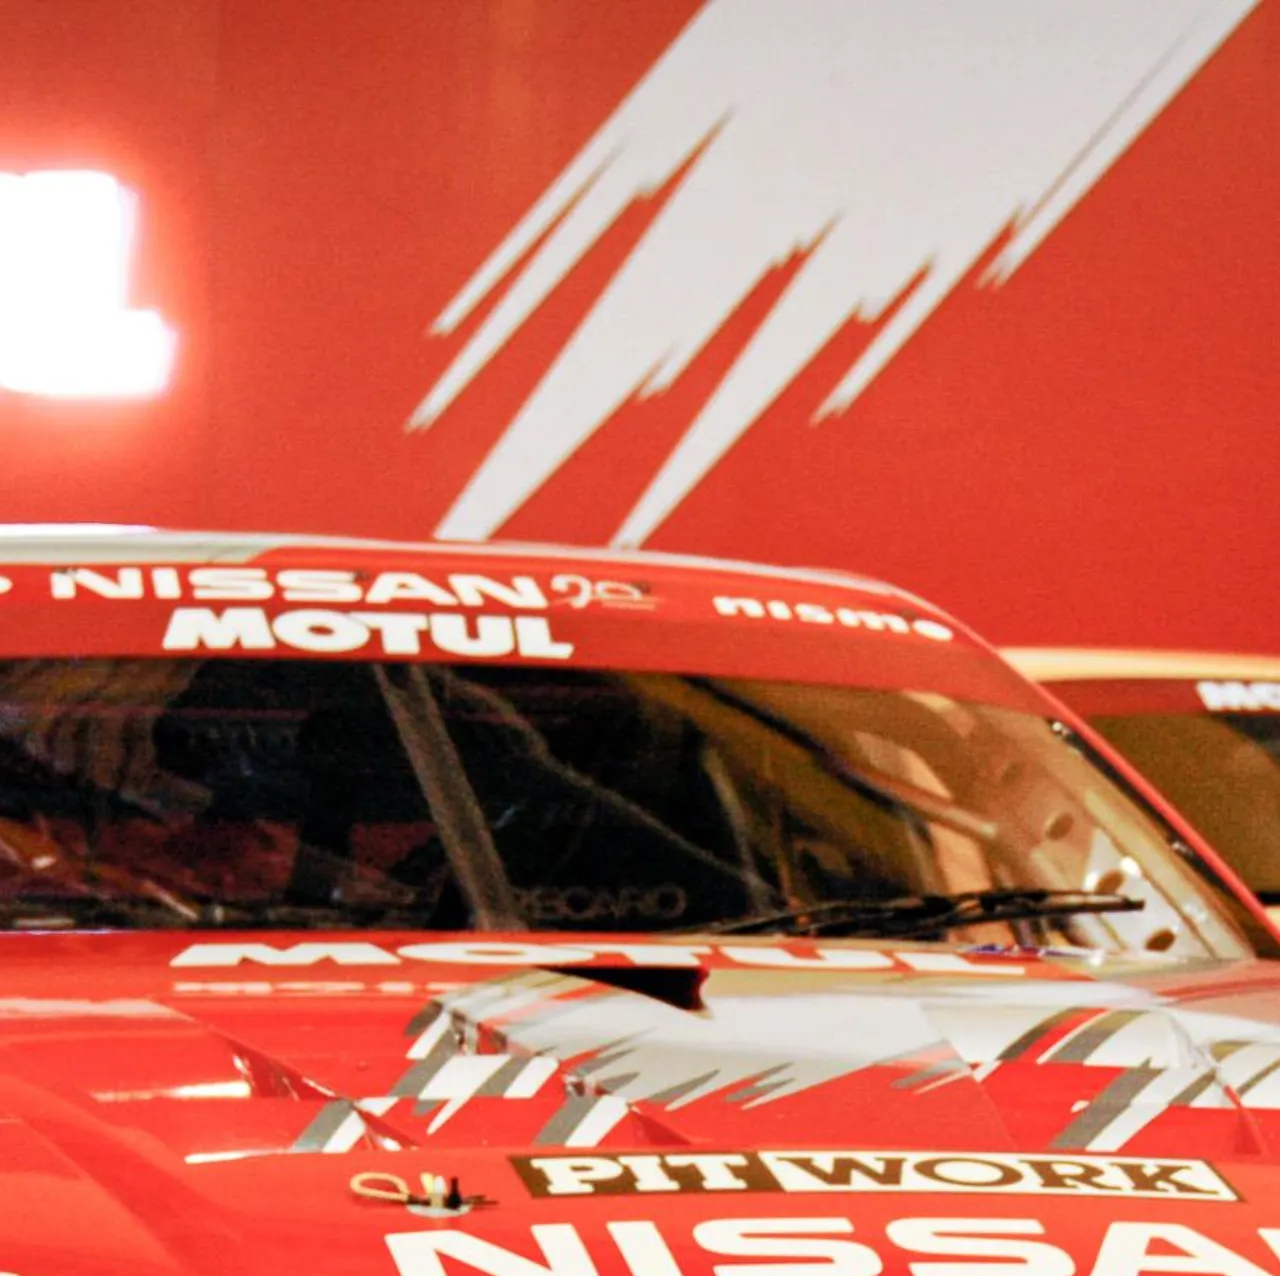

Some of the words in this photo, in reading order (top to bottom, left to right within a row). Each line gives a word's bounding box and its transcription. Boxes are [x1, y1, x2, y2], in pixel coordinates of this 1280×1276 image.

[53, 568, 548, 607] NISSAN
[162, 607, 574, 659] MOTUL
[713, 596, 953, 641] nismo
[169, 941, 1025, 975] MOTUL
